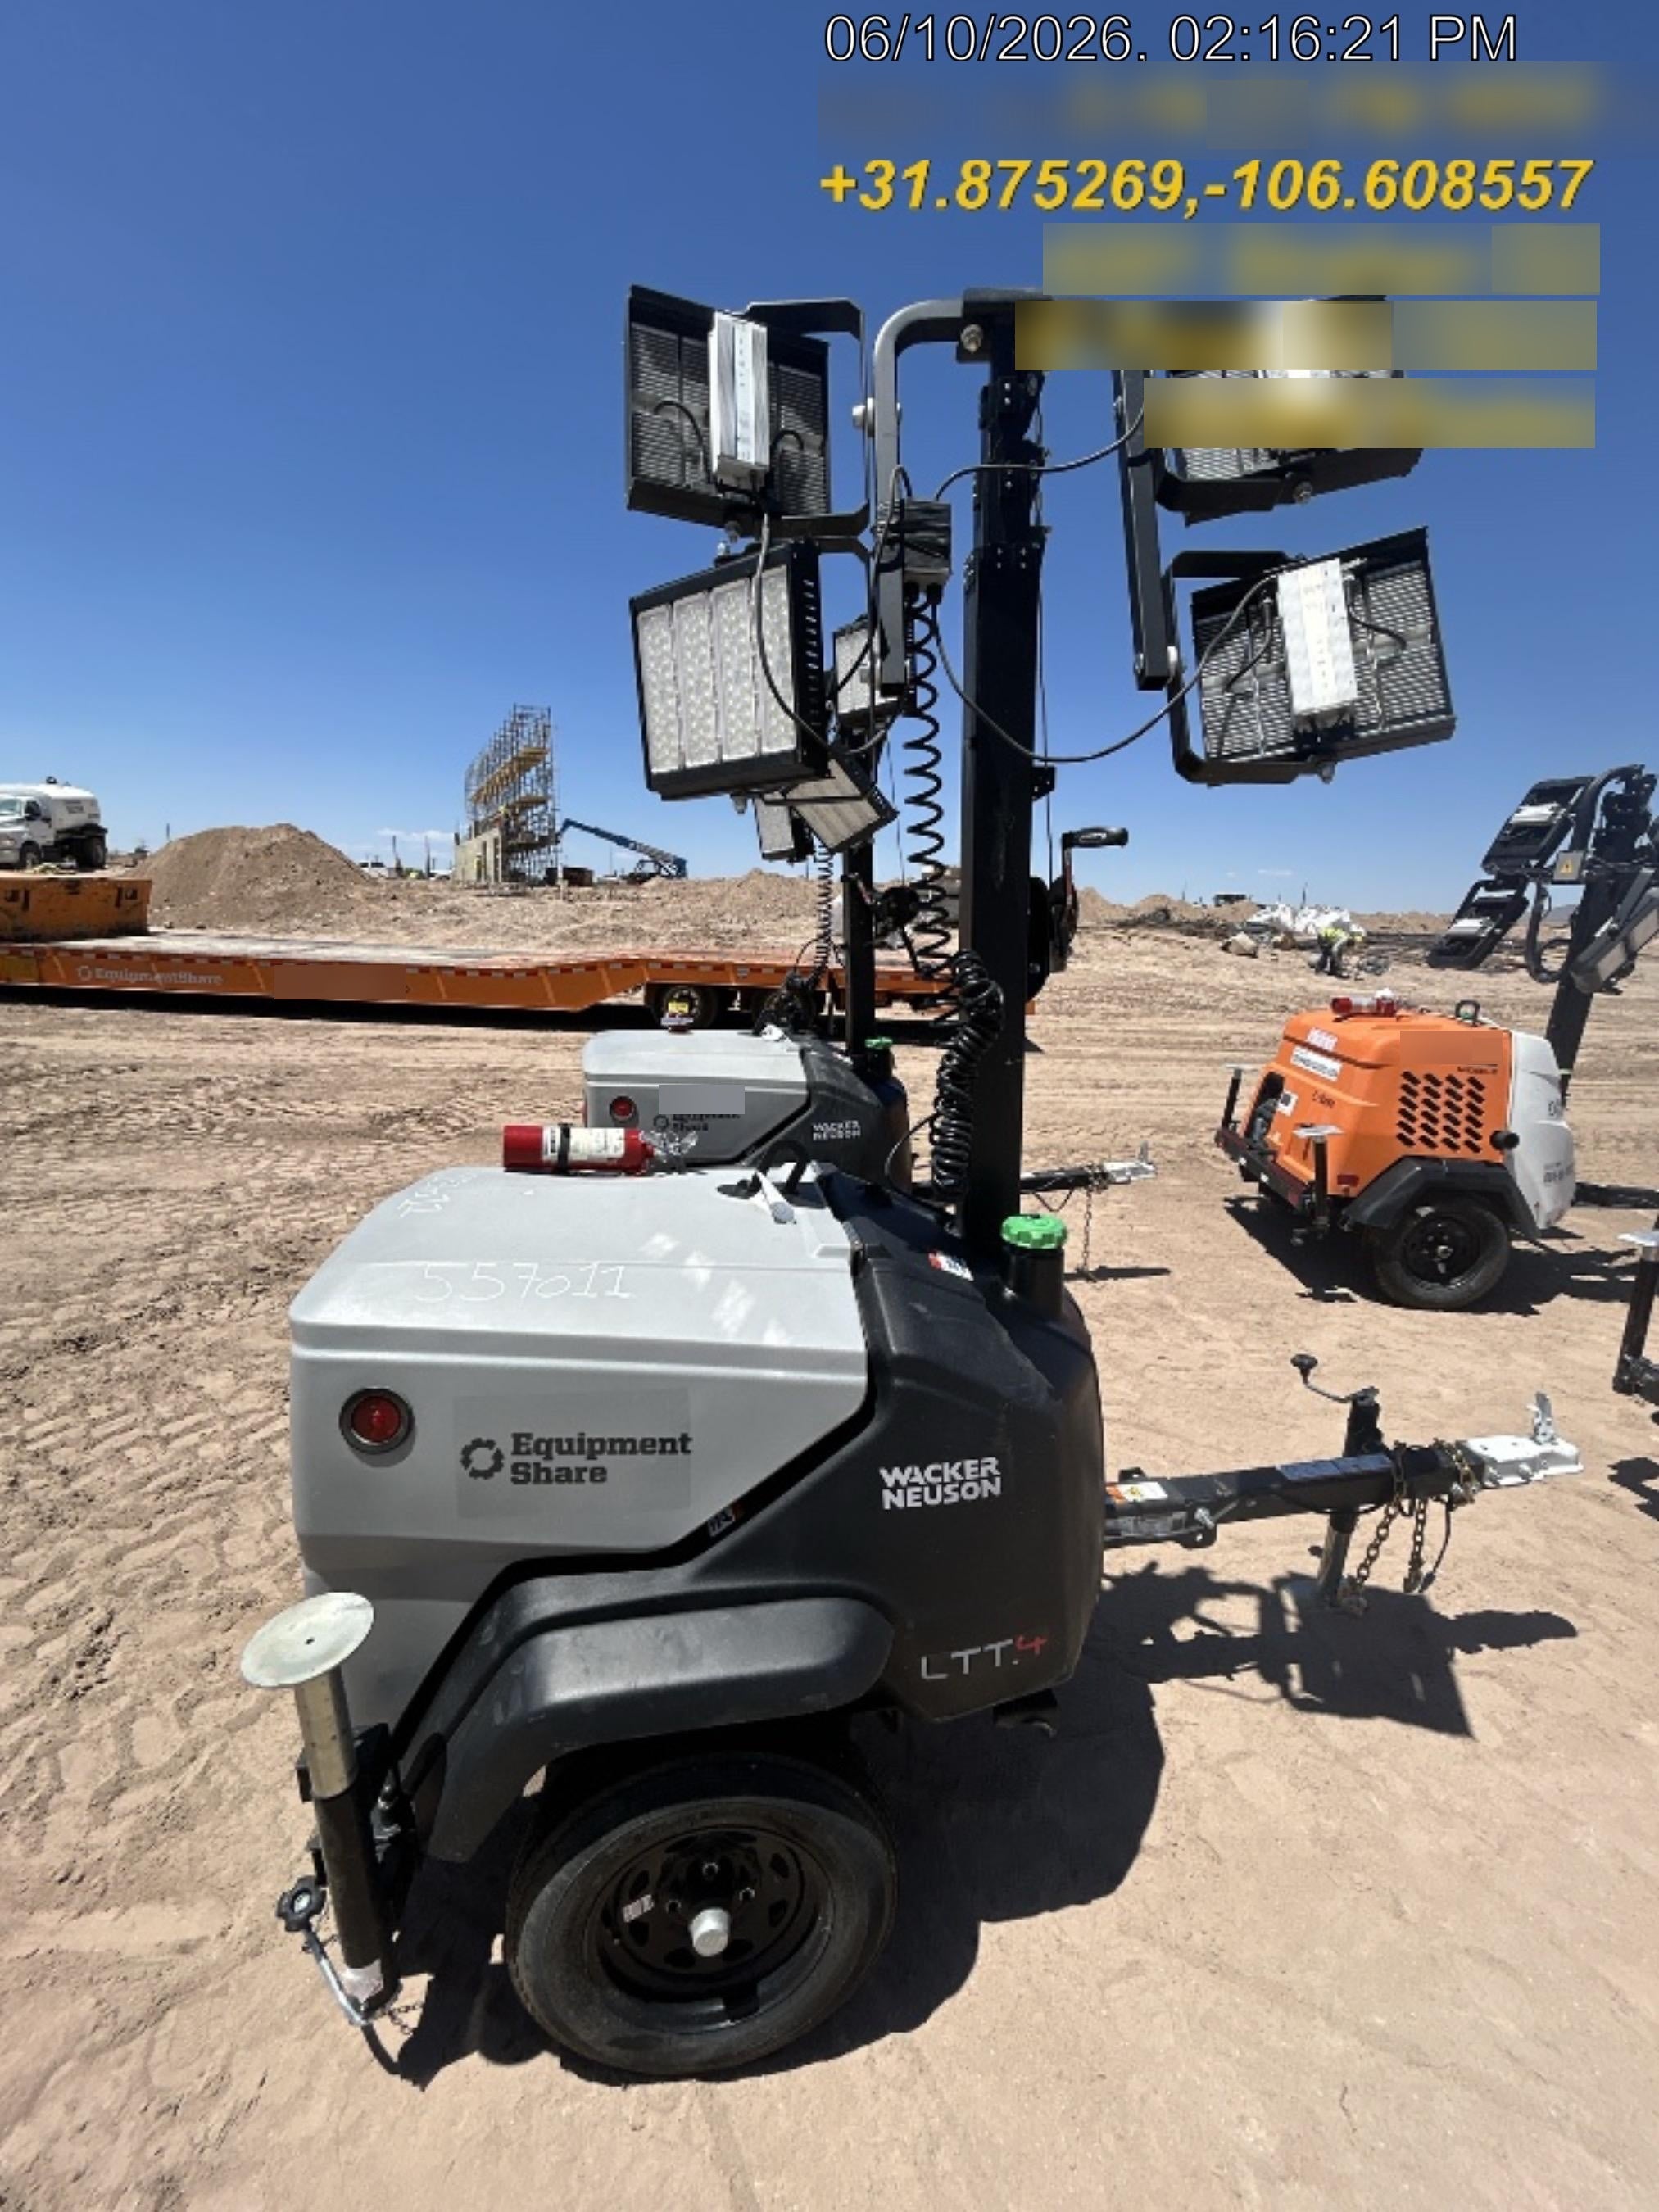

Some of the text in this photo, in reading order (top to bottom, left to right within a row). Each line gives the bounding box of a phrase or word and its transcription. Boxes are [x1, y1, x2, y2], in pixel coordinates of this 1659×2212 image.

[412, 1262, 636, 1302] 557011
[510, 1432, 694, 1460] Equipment
[510, 1462, 608, 1484] Share
[879, 1457, 1001, 1488] WACKER
[882, 1477, 1002, 1510] NEUSON
